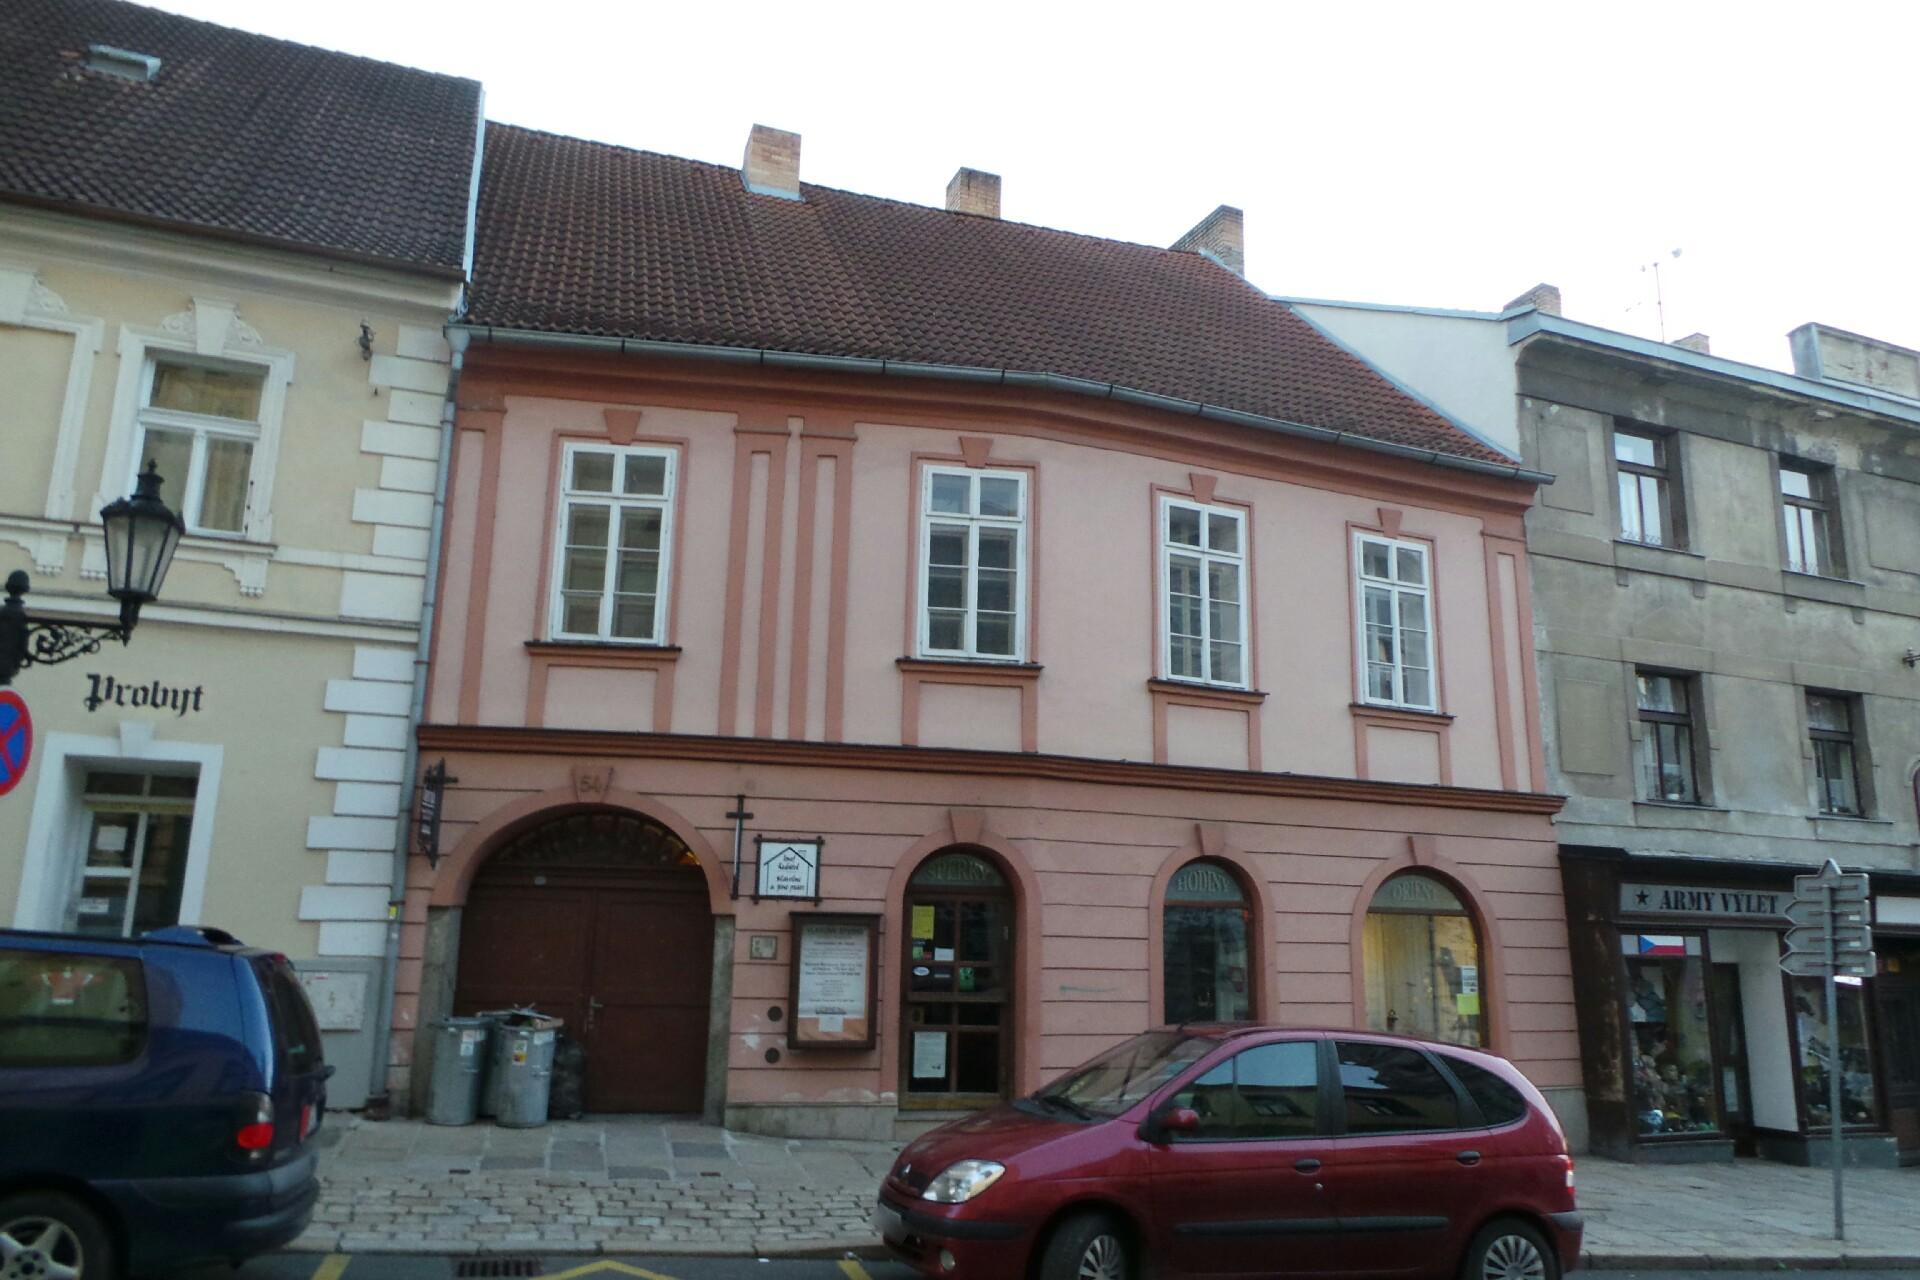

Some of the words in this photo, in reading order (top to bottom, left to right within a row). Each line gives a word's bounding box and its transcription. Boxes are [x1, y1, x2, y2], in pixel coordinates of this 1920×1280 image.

[84, 673, 204, 718] Probyt
[1177, 870, 1230, 892] HODINY
[1659, 890, 1715, 911] ARMY
